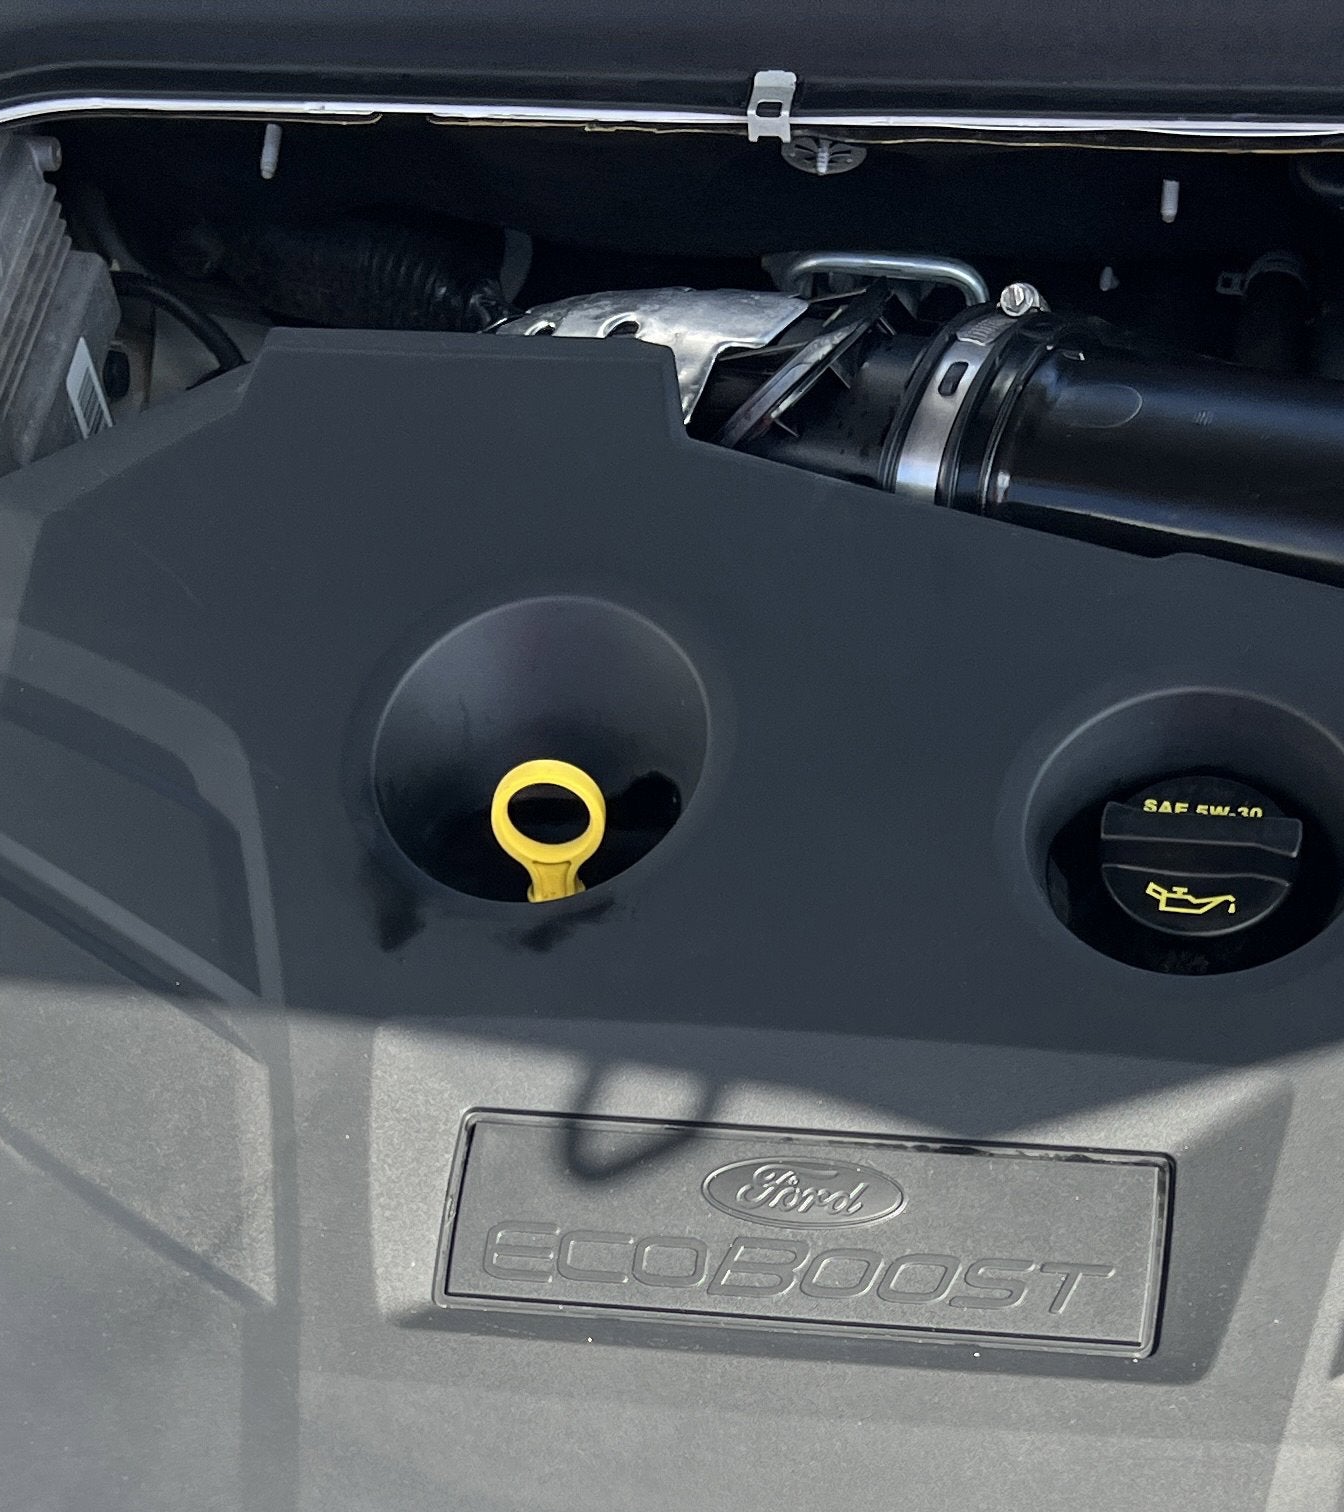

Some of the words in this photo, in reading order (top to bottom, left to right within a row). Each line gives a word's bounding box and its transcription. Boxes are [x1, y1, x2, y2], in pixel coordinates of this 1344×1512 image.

[1143, 799, 1189, 814] SAE
[1196, 804, 1263, 818] 5W-30
[736, 1163, 864, 1218] Ford
